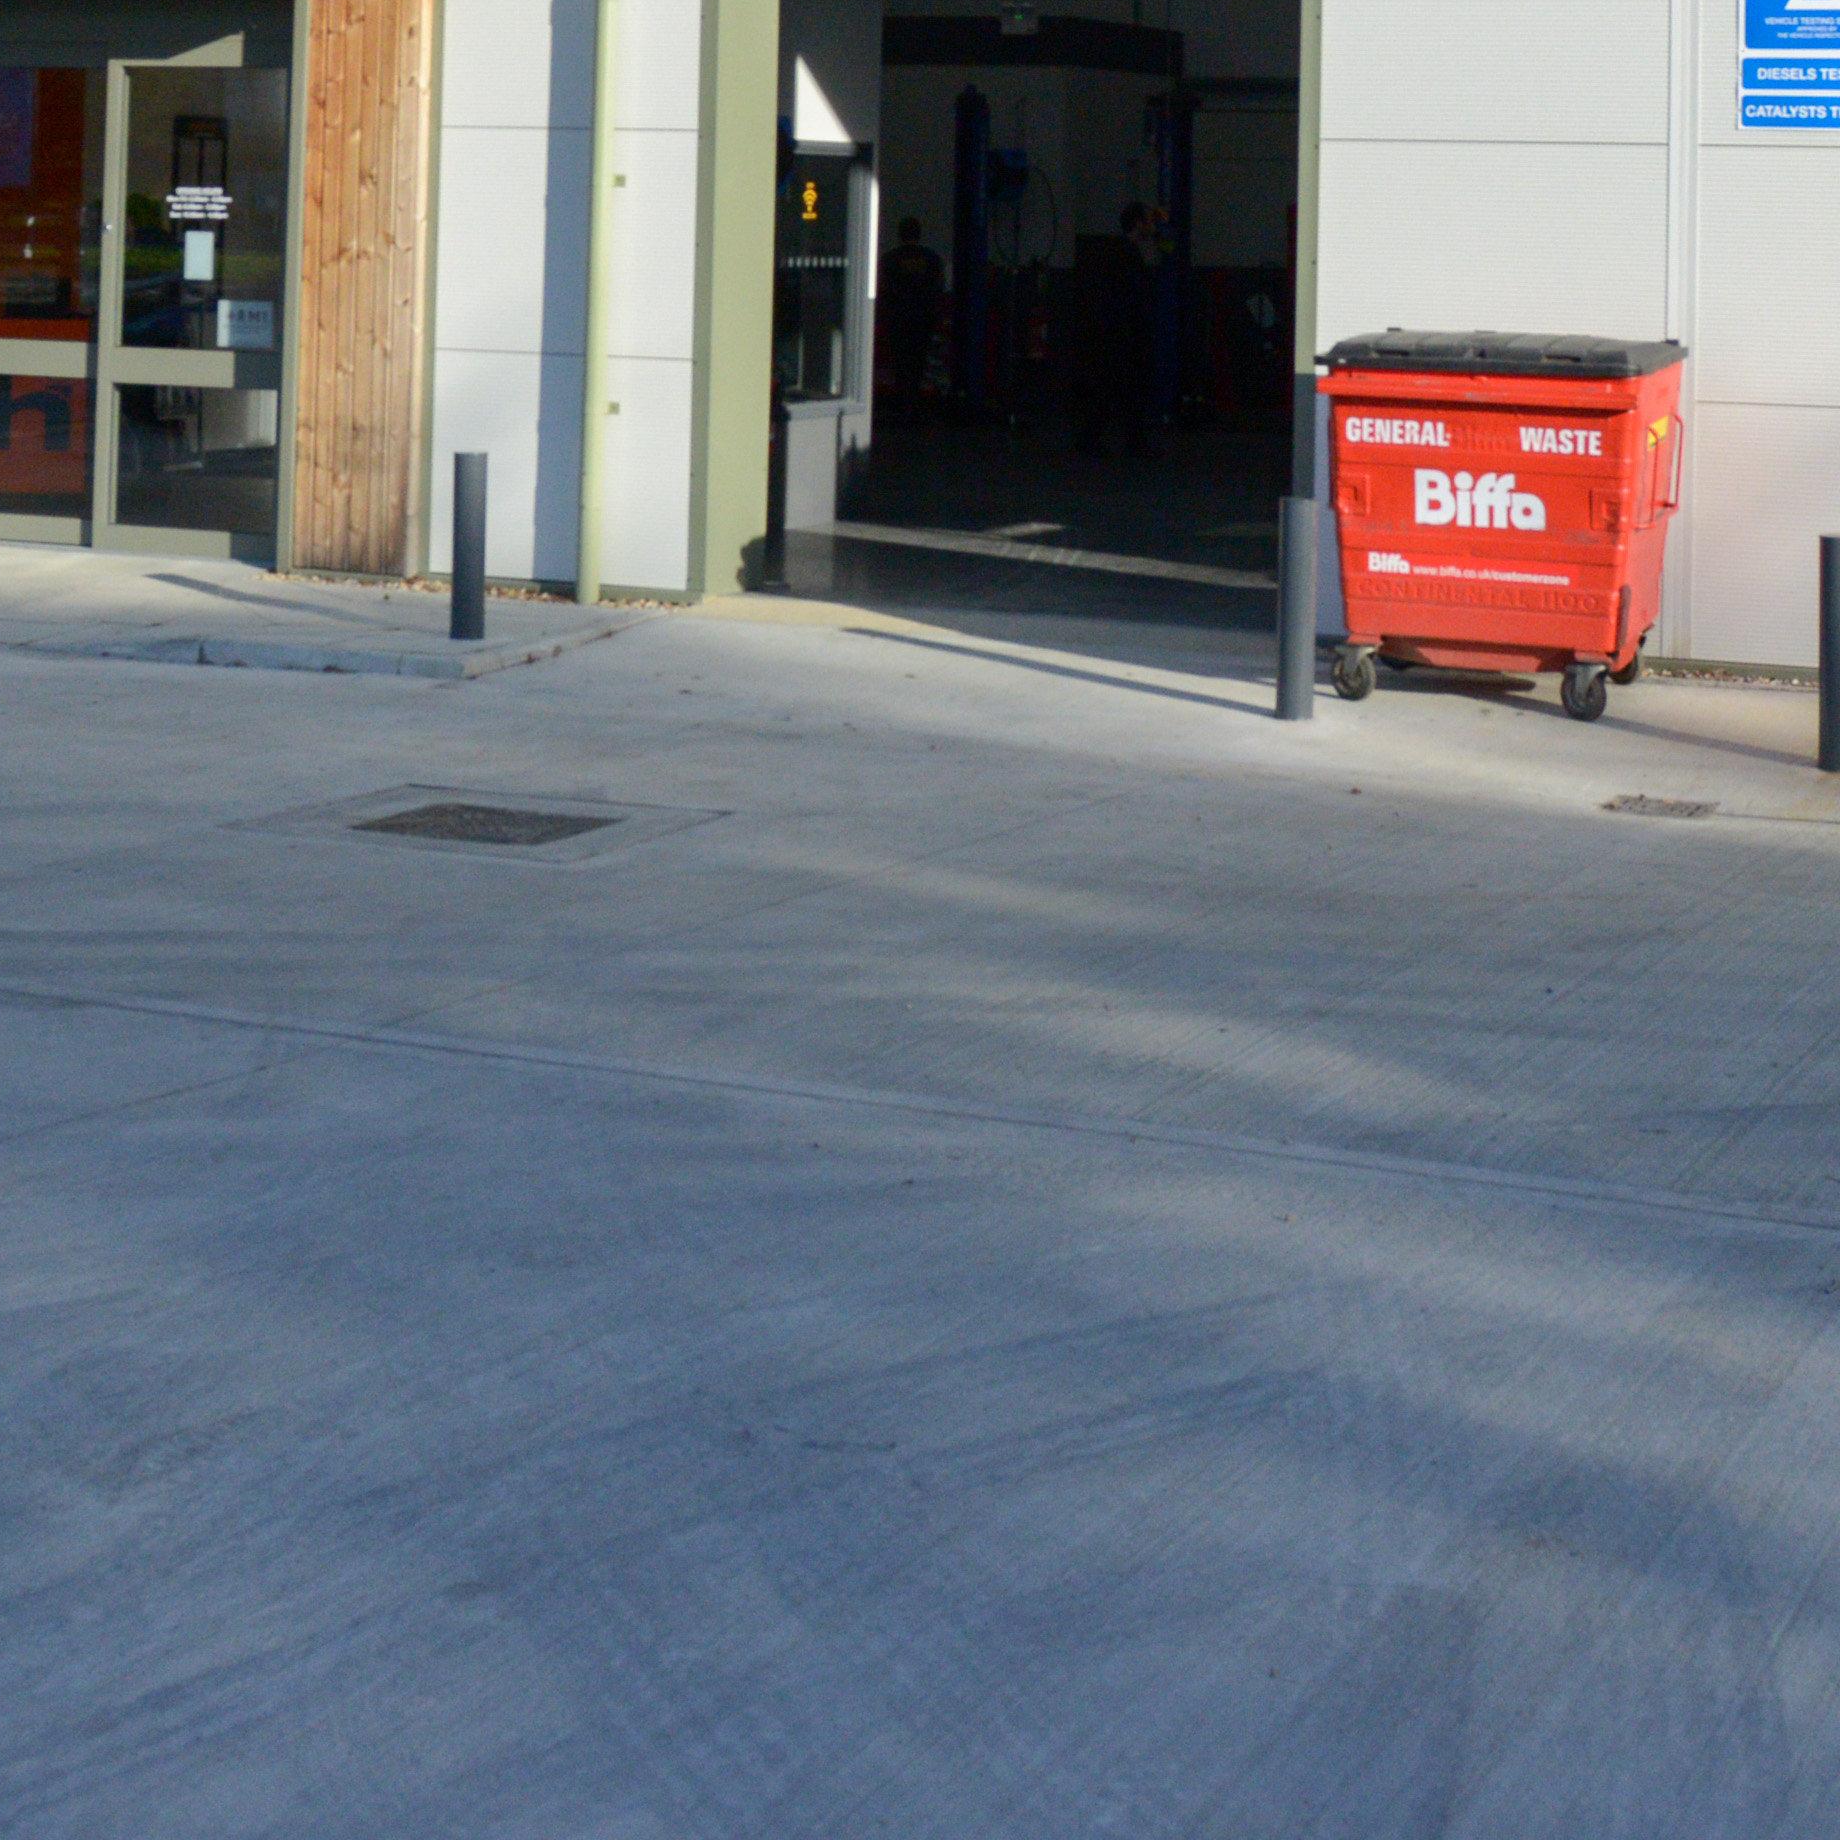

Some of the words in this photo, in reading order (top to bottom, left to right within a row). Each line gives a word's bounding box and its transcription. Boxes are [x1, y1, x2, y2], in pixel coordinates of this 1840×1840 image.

[1757, 67, 1817, 81] DIESELS
[1745, 104, 1827, 118] CATALYSTS
[1345, 416, 1450, 447] GENERAL
[1519, 426, 1604, 456] WASTE
[1413, 468, 1547, 531] Biffa
[1368, 550, 1410, 575] Biffa
